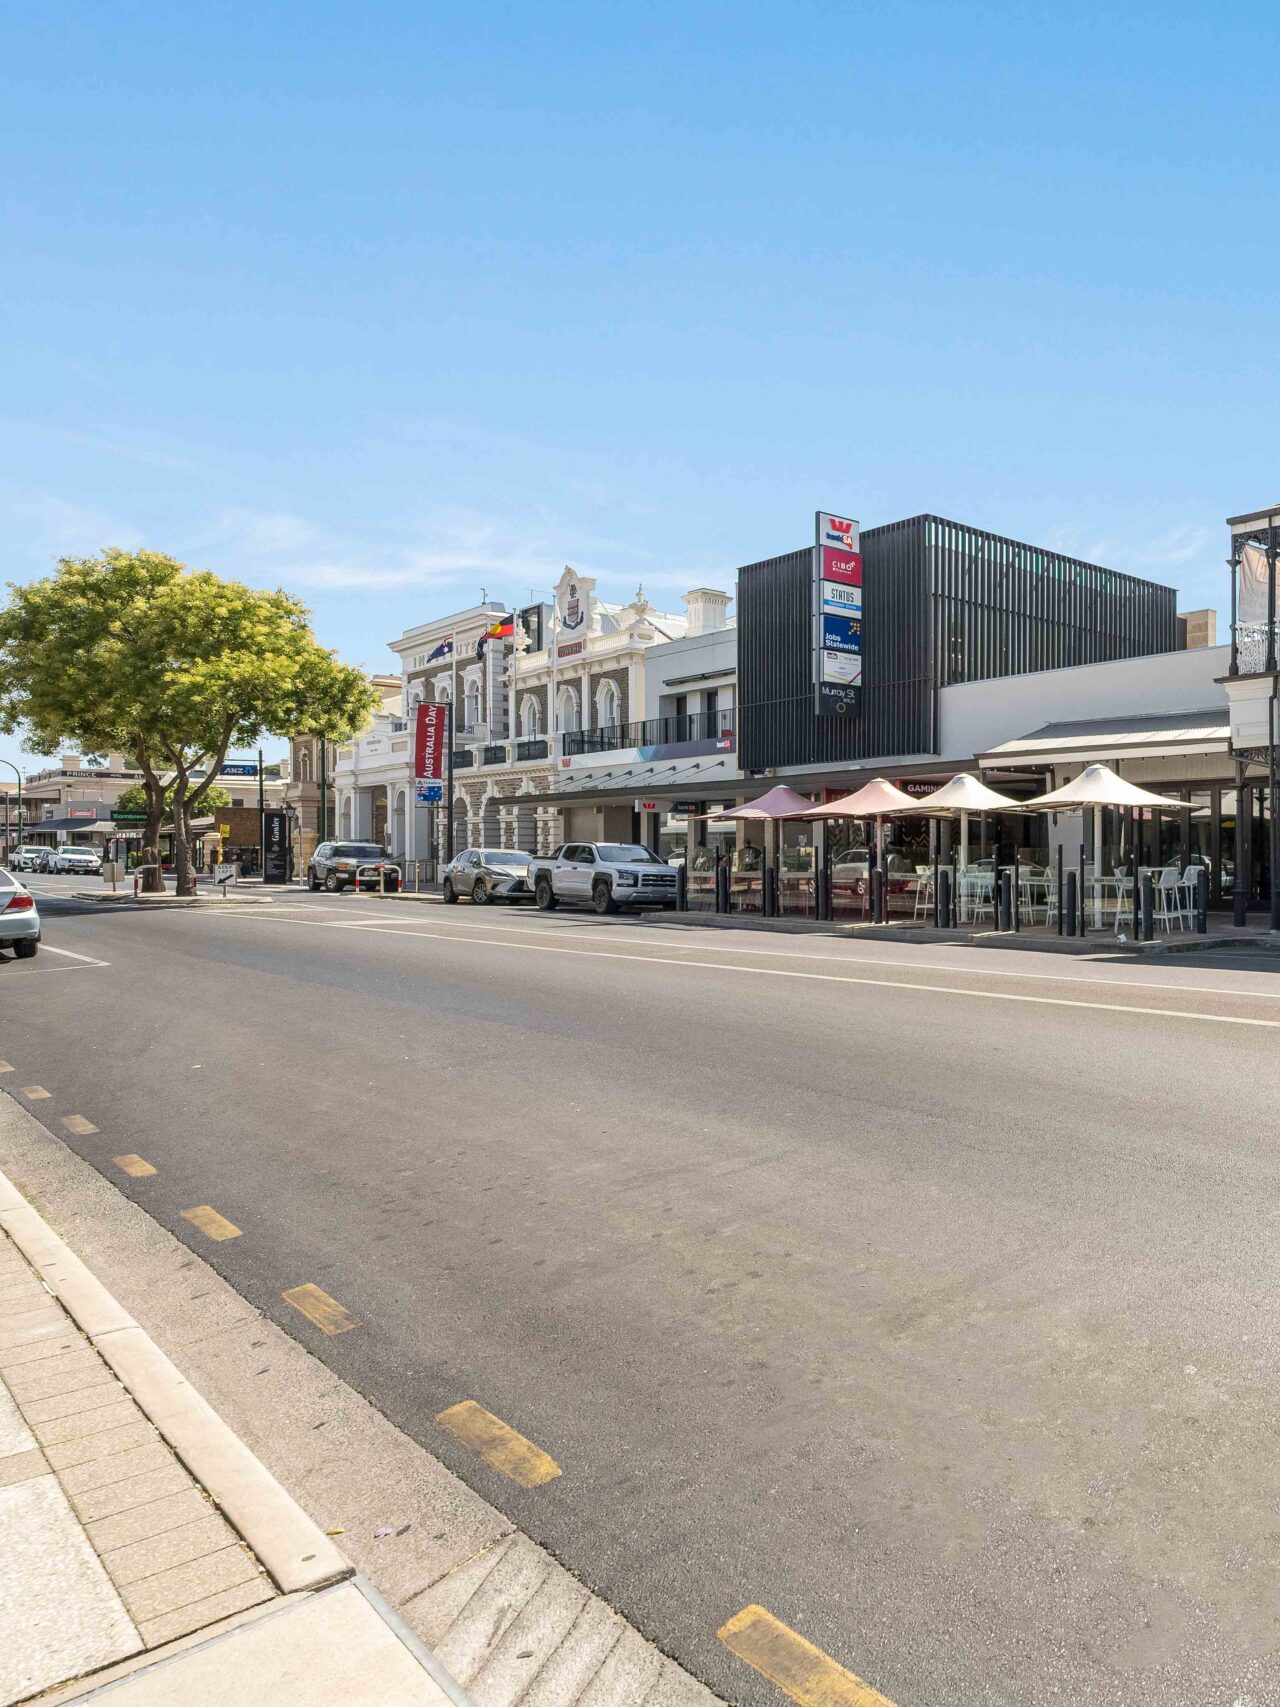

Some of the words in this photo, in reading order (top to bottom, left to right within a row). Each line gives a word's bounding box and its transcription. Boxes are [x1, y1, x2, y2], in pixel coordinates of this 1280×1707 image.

[831, 588, 855, 603] STATUS
[825, 632, 841, 641] Jobs
[413, 639, 478, 669] INUTE
[825, 640, 859, 651] Statewide
[821, 686, 846, 698] Murray
[425, 704, 438, 724] DAY
[423, 727, 435, 778] AUSTRALIA
[271, 817, 280, 841] Gawler
